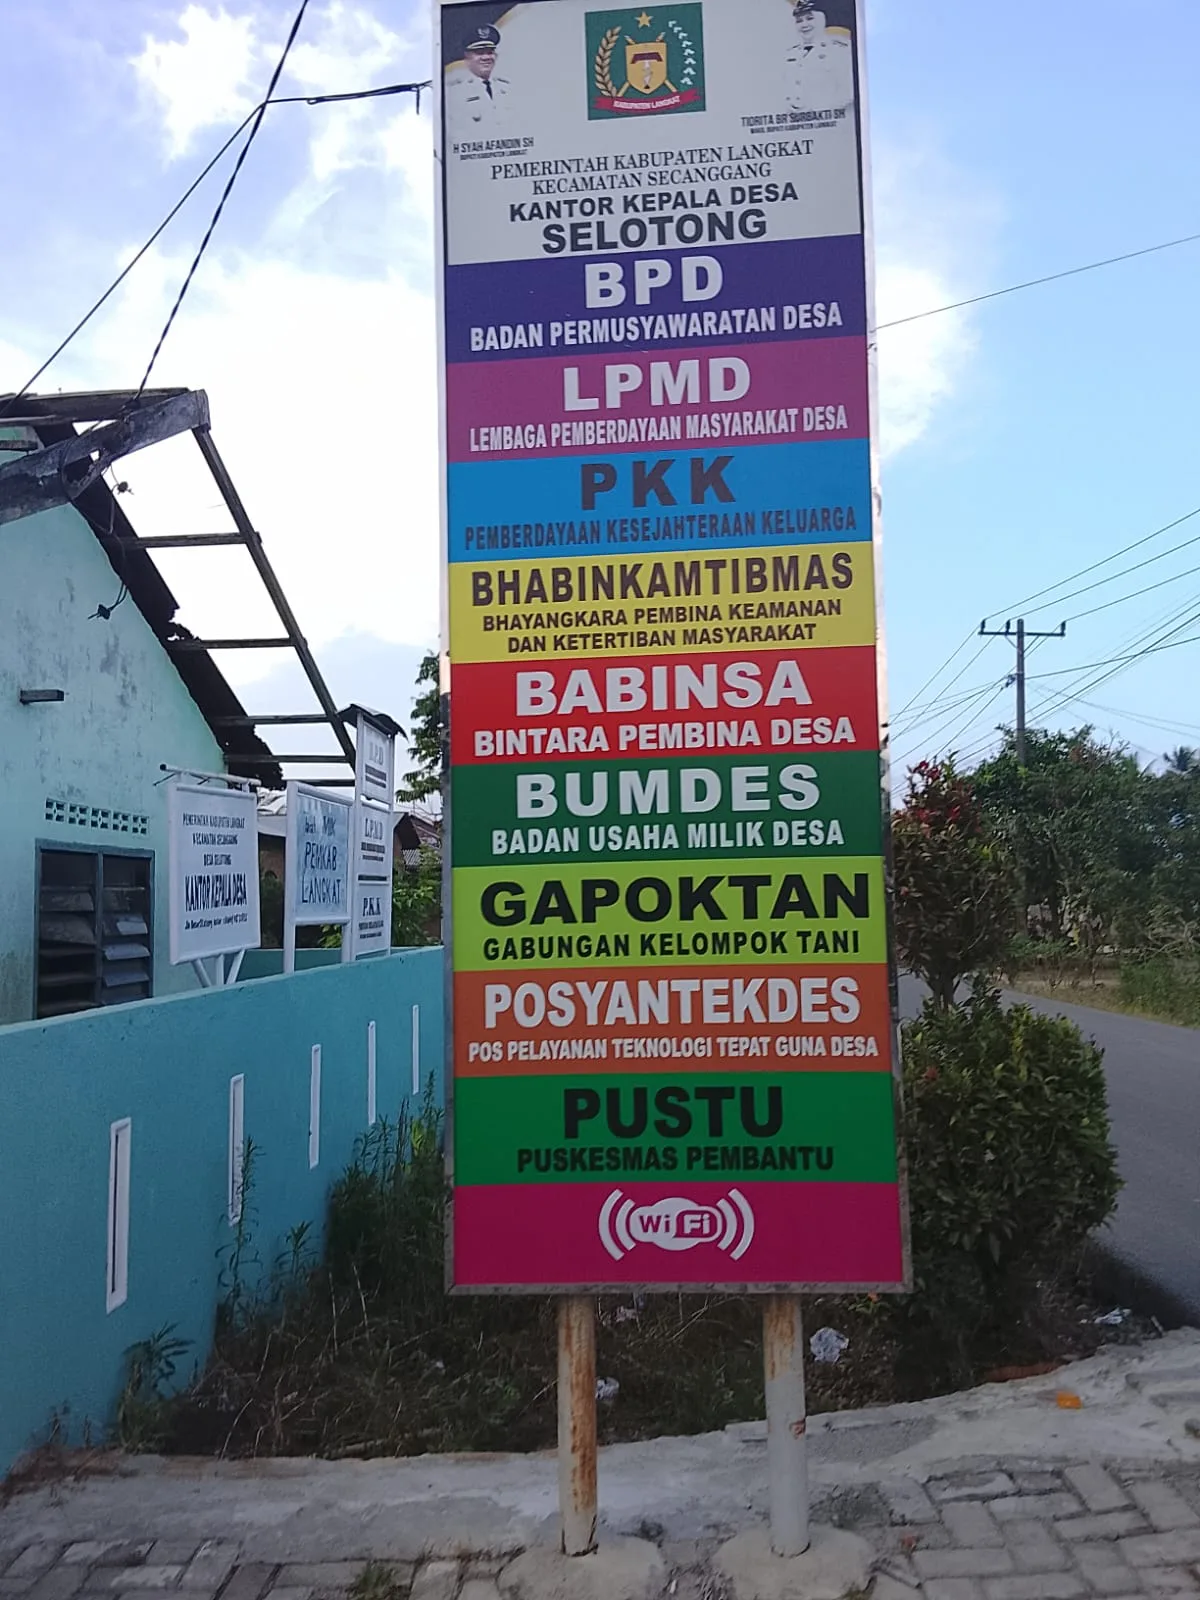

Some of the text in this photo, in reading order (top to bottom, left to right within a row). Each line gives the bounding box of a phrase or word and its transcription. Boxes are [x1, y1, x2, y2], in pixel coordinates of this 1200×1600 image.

[461, 141, 484, 153] SYAH
[522, 136, 534, 148] SH
[491, 140, 814, 180] PEMERINTAH KABUPATEN LANGKAT
[532, 162, 772, 196] KECAMATAN SECANGGANG
[510, 182, 799, 222] KANTOR KEPALA DESA
[542, 208, 766, 254] SELOTONG
[584, 255, 724, 309] BPD
[470, 302, 843, 352] BADAN PERMUSYAWARATAN DESA
[562, 356, 751, 412] LPMD
[470, 405, 848, 452] LEMBAGA PEMBERDAYAAN MASYARAKAT DESA
[581, 456, 736, 510] PKK
[465, 506, 857, 551] PEMBERDAYAAN KESEJAHTERAAN KELUARGA
[471, 552, 853, 607] BHABINKAMTIBMAS
[482, 598, 842, 632] BHAYANGKARA PEMBINA KEAMANAN
[507, 623, 817, 654] DAN KETERTIBAN MASYARAKAT
[515, 660, 812, 717] BABINSA
[474, 716, 856, 757] BINTARA PEMBINA DESA
[516, 764, 820, 820] BUMDES
[492, 819, 845, 856] BADAN USAHA MILIK DESA
[185, 874, 210, 912] KANTOR
[232, 872, 248, 906] DESA
[302, 877, 342, 904] LANGKAT
[480, 873, 870, 926] GAPOKTAN
[482, 930, 860, 962] GABUNGAN KELOMPOK TANI
[484, 976, 860, 1029] POSYANTEKDES
[468, 1035, 879, 1062] POS PELAYANAN TEKNOLOGI TEPAT GUNA DESA
[563, 1086, 783, 1140] PUSTU
[516, 1146, 834, 1174] PUSKESMAS PEMBANTU
